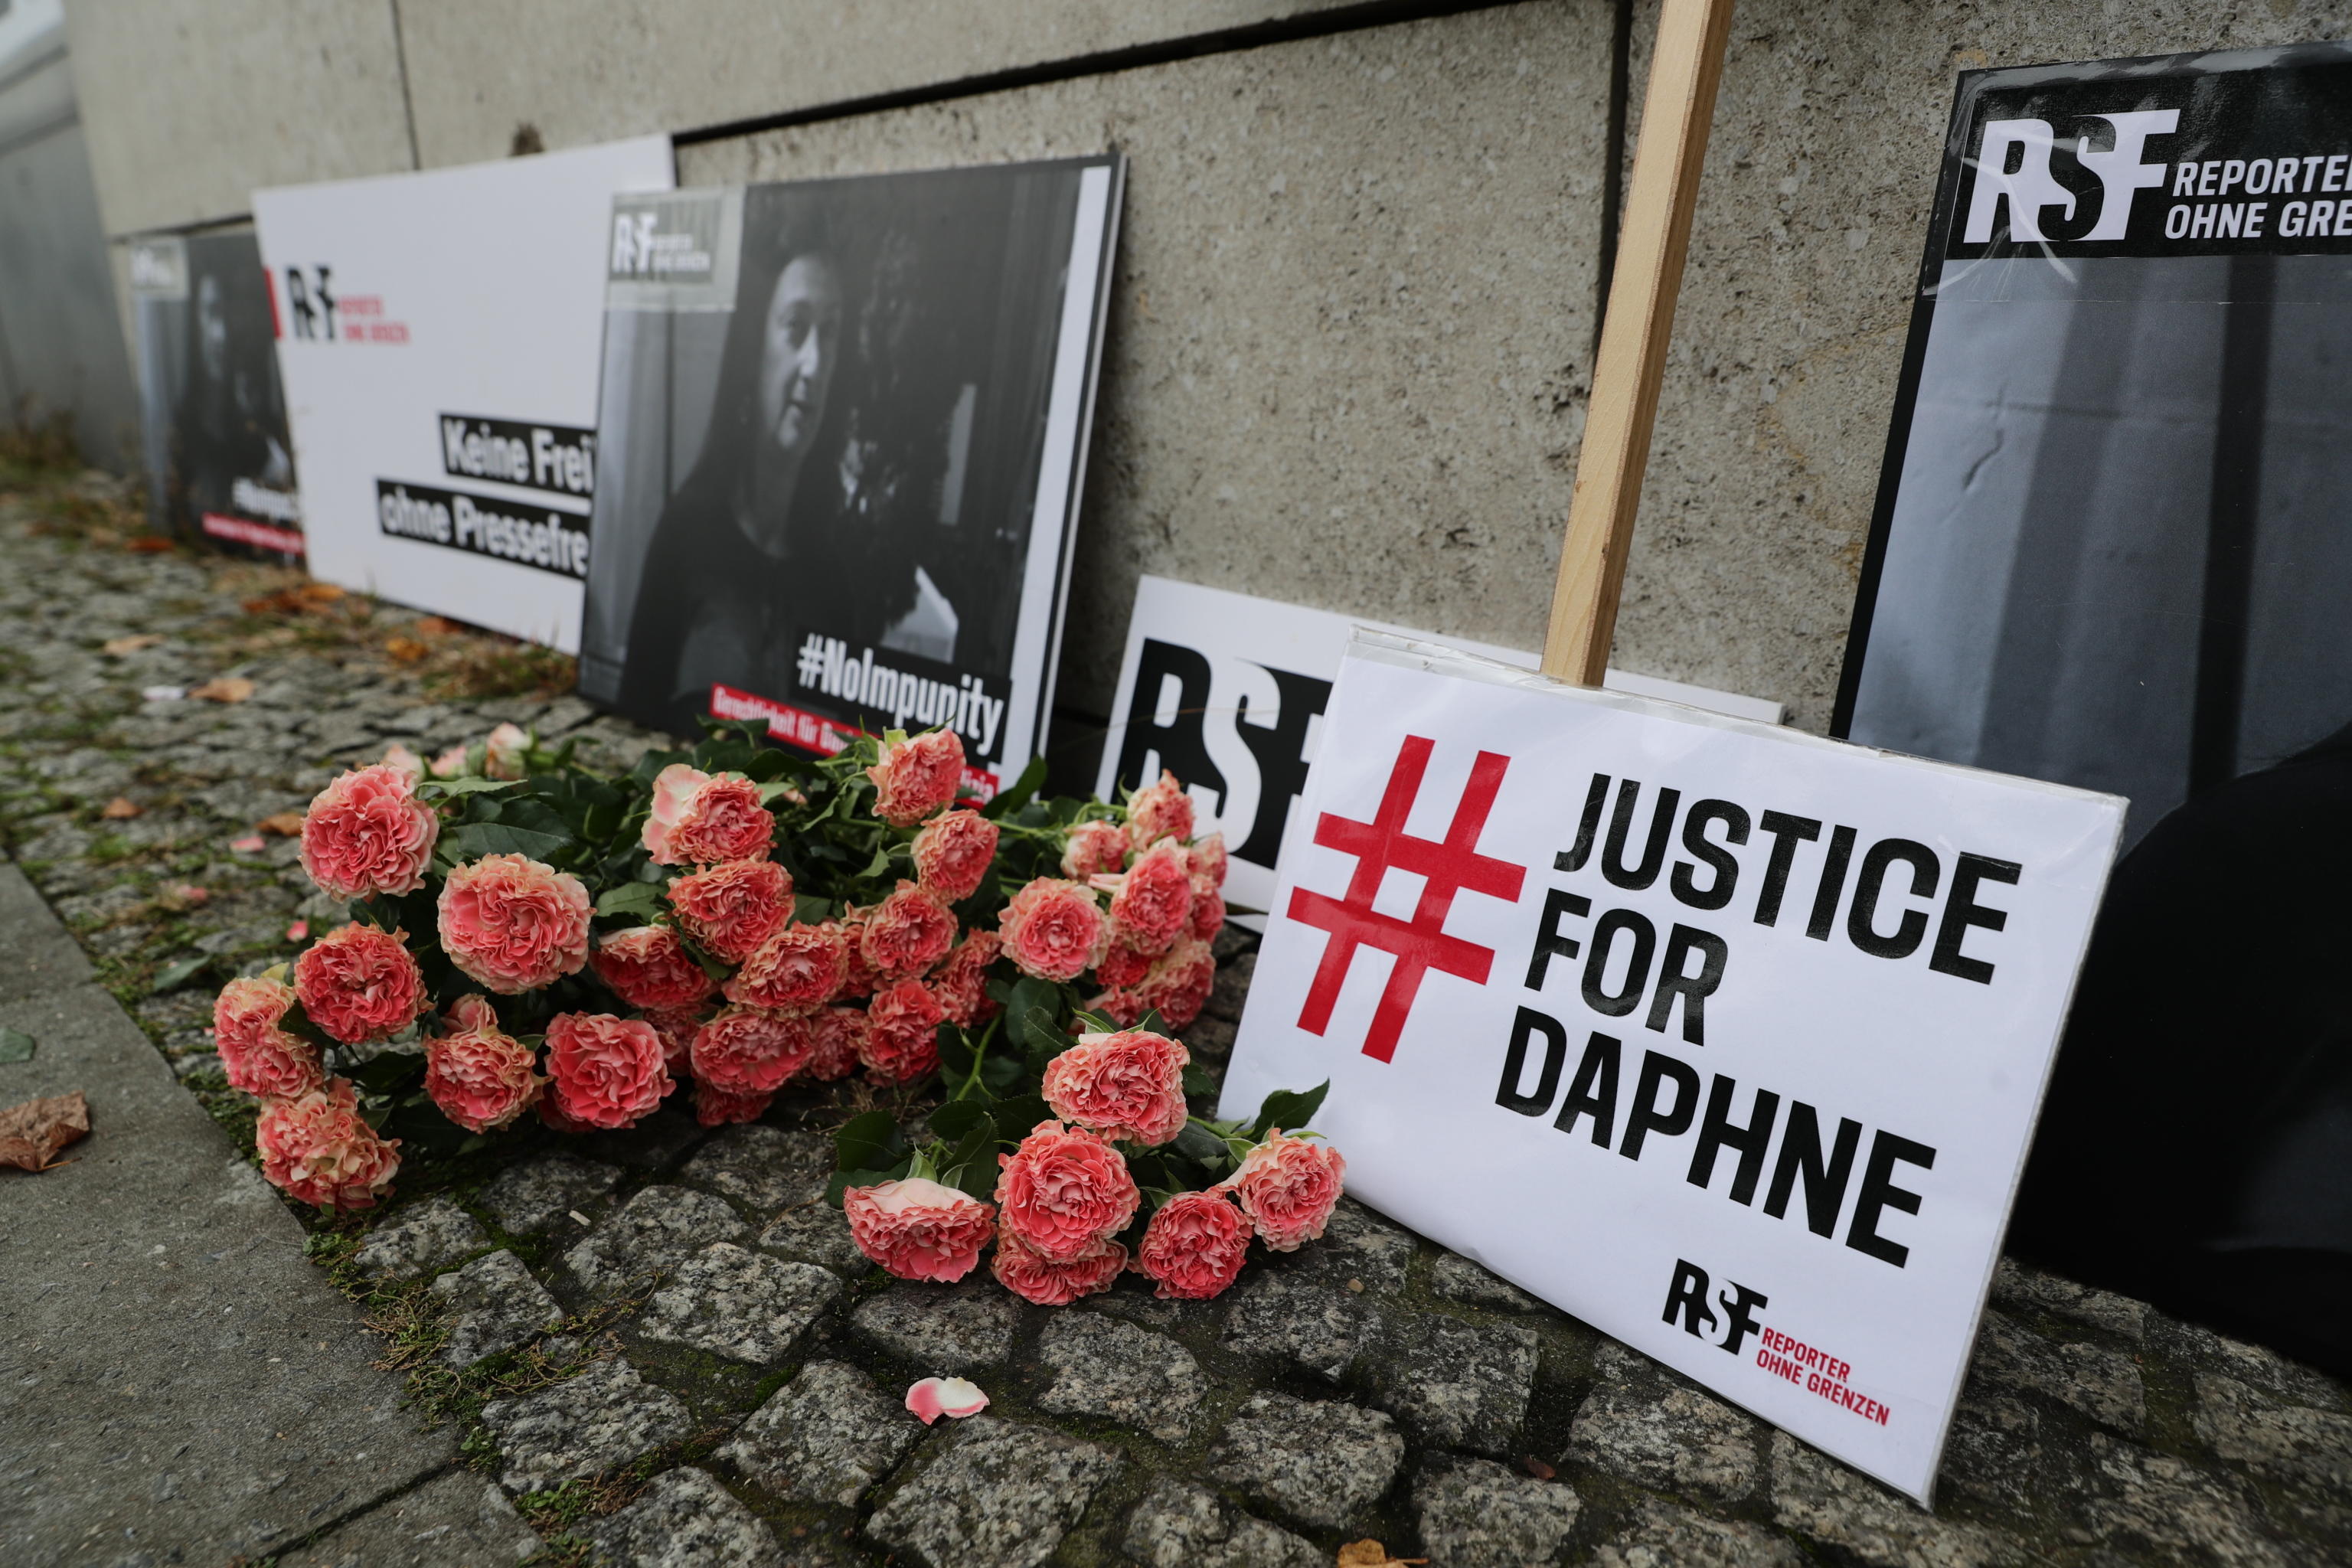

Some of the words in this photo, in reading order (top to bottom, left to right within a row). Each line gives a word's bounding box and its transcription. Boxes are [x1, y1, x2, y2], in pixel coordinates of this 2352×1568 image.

[1963, 108, 2180, 243] RSF
[2165, 202, 2267, 240] OHNE
[2278, 199, 2352, 237] GRE
[2173, 155, 2352, 198] REPORTE
[444, 418, 530, 482] Keine
[531, 427, 596, 494] Frei
[381, 485, 452, 543] ohne
[452, 494, 590, 576] Pressefre
[796, 632, 1004, 756] #NoImpunity
[1110, 637, 1334, 871] RSF
[1553, 773, 2022, 985] JUSTICE
[1524, 887, 1728, 1047] FOR
[1494, 1005, 1936, 1268] DAPHNE
[1662, 1258, 1768, 1355] RSF
[1761, 1327, 1851, 1380] REPORTER
[1756, 1348, 1804, 1385] OHNE
[1807, 1373, 1890, 1426] GRENZEN
